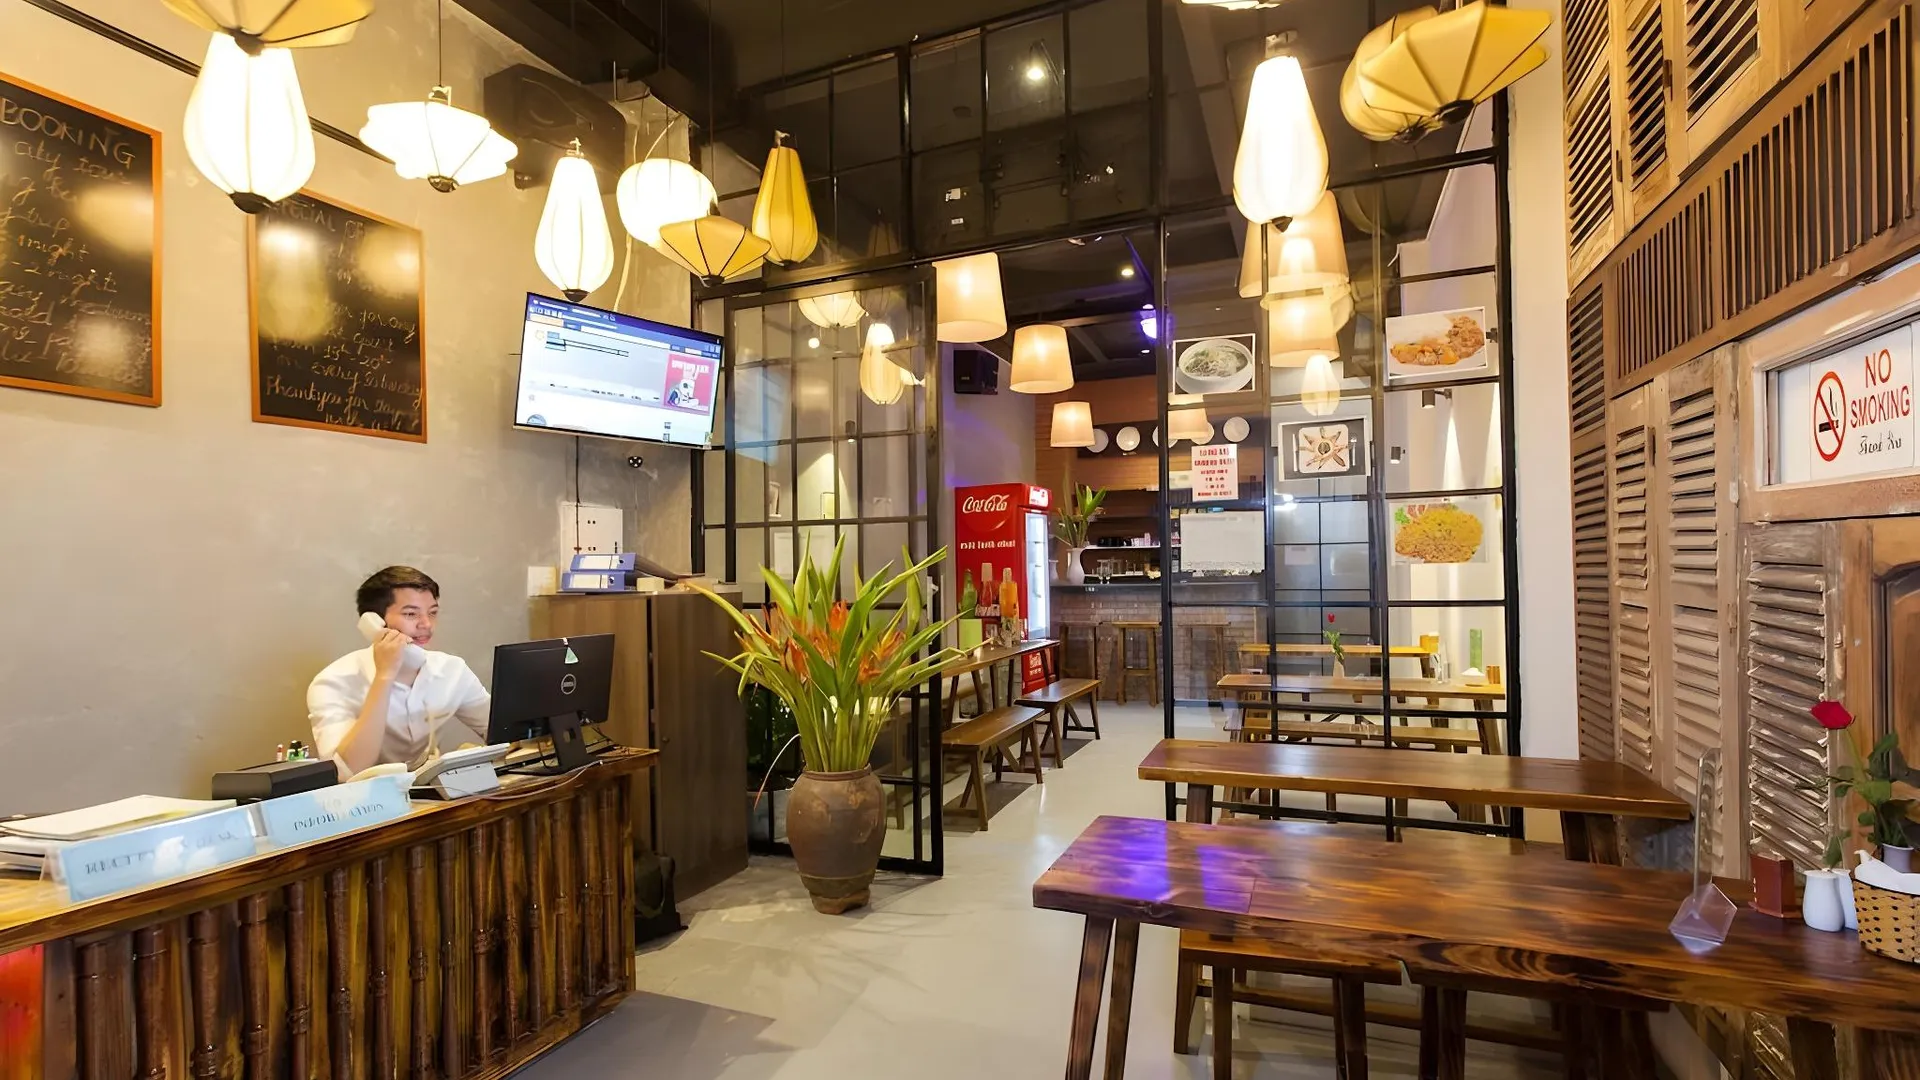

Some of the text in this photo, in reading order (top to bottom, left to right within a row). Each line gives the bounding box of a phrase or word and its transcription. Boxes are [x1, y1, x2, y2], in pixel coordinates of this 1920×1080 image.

[0, 98, 136, 170] BOOKING
[1865, 349, 1891, 388] NO
[1850, 385, 1910, 428] SMOKING
